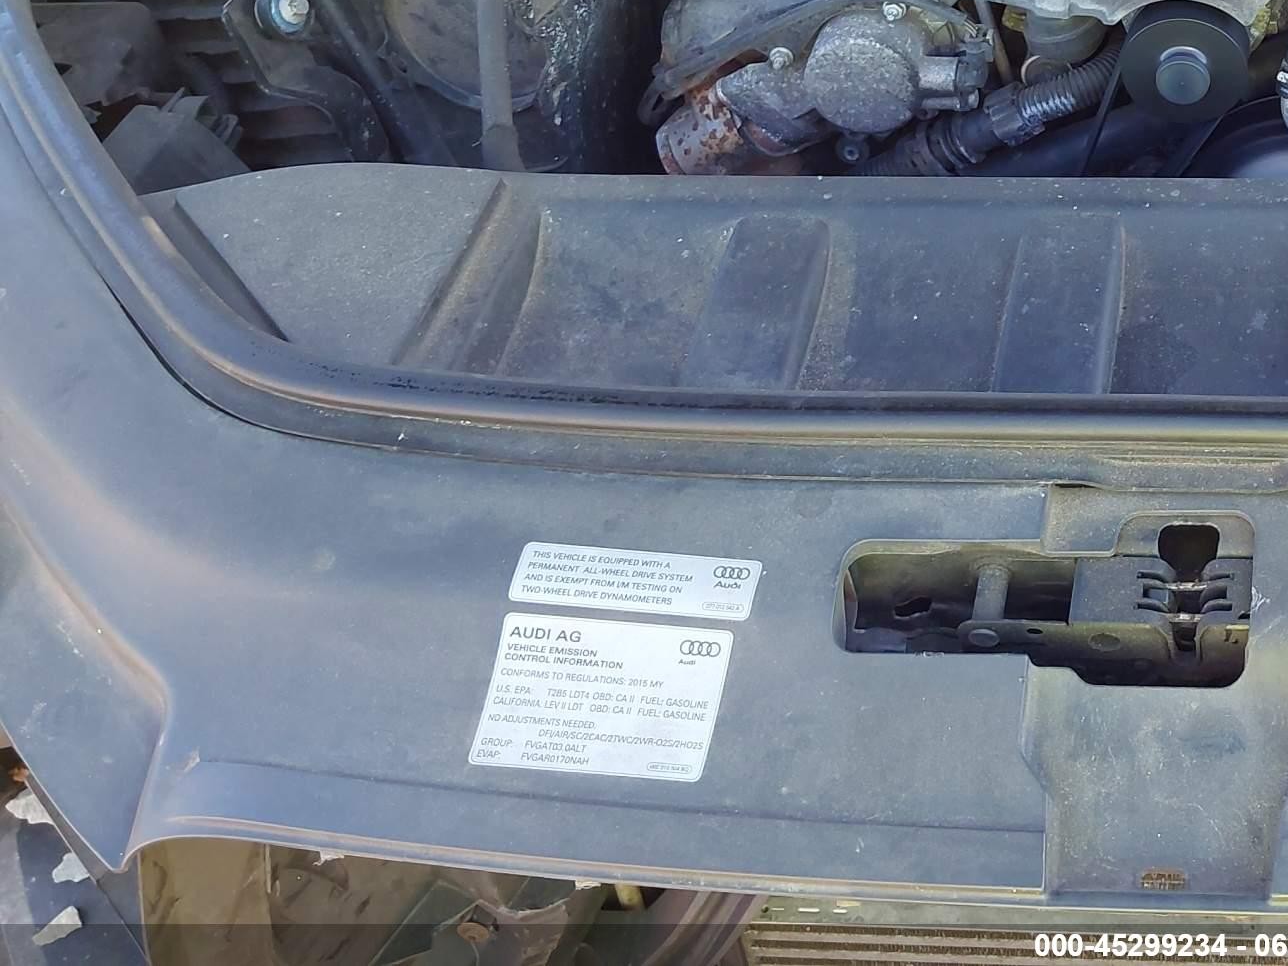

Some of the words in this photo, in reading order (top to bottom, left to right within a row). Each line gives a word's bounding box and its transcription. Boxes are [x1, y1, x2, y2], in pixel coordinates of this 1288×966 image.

[533, 550, 552, 559] THIS
[553, 552, 587, 562] VEHICLE
[598, 556, 640, 566] EQUIPPED
[641, 560, 663, 568] WITH
[528, 562, 580, 572] PERMANENT
[583, 567, 630, 577] ALL-WHEEL
[631, 570, 656, 579] DRIVE
[657, 573, 693, 582] SYSTEM
[524, 573, 543, 581] AND
[554, 576, 588, 584] EXEMPT
[590, 579, 615, 587] FROM
[631, 582, 667, 592] TESTING
[669, 585, 683, 593] ON
[713, 581, 742, 589] Audi
[521, 585, 571, 597] TWO-WHEEL
[573, 589, 599, 599] DRIVE
[600, 592, 672, 605] DYNAMOMETERS
[509, 626, 551, 640] AUDI
[556, 630, 582, 642] AG
[507, 643, 547, 653] VEHICLE
[549, 647, 598, 657] EMISSION
[504, 653, 551, 663] CONTROL
[553, 657, 623, 669] INFORMATION
[500, 668, 550, 679] CONFORMS
[552, 672, 564, 680] TO
[565, 674, 626, 685] REGULATIONS:
[628, 678, 648, 687] 2015
[649, 680, 665, 688] MY
[496, 684, 511, 693] U.S.
[592, 691, 614, 701] OBD:
[615, 693, 627, 702] CA
[640, 696, 664, 706] FUEL:
[665, 698, 710, 709] GASOLINE
[544, 700, 560, 709] LEV
[568, 702, 584, 711] LDT
[589, 704, 611, 713] OBD:
[612, 705, 624, 714] CA
[663, 710, 707, 721] GASOLINE
[487, 714, 501, 722] NO
[502, 715, 561, 727] ADJUSTMENTS
